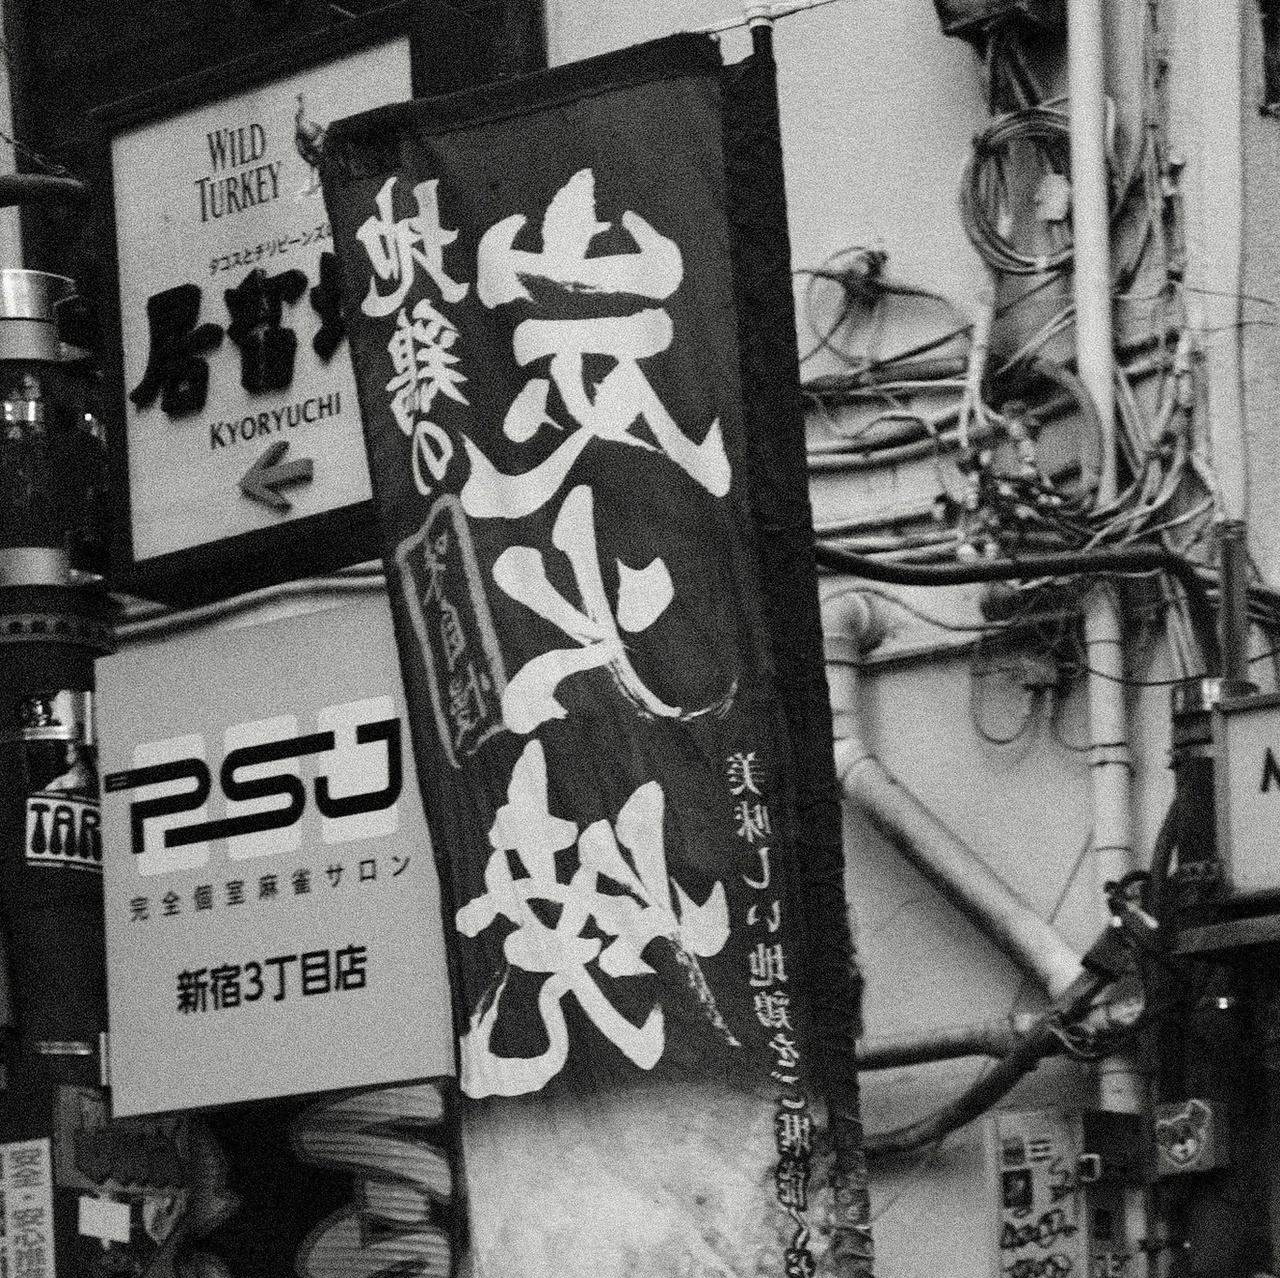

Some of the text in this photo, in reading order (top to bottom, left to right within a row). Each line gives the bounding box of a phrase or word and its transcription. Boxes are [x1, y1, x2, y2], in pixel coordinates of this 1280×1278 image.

[207, 123, 265, 172] WILD
[194, 161, 281, 222] TURKEY
[209, 393, 341, 449] KYORYUCHI
[103, 717, 401, 854] PSJ
[130, 856, 411, 922] 完全個室麻雀サロン
[177, 944, 368, 1015] 新宿3丁目店
